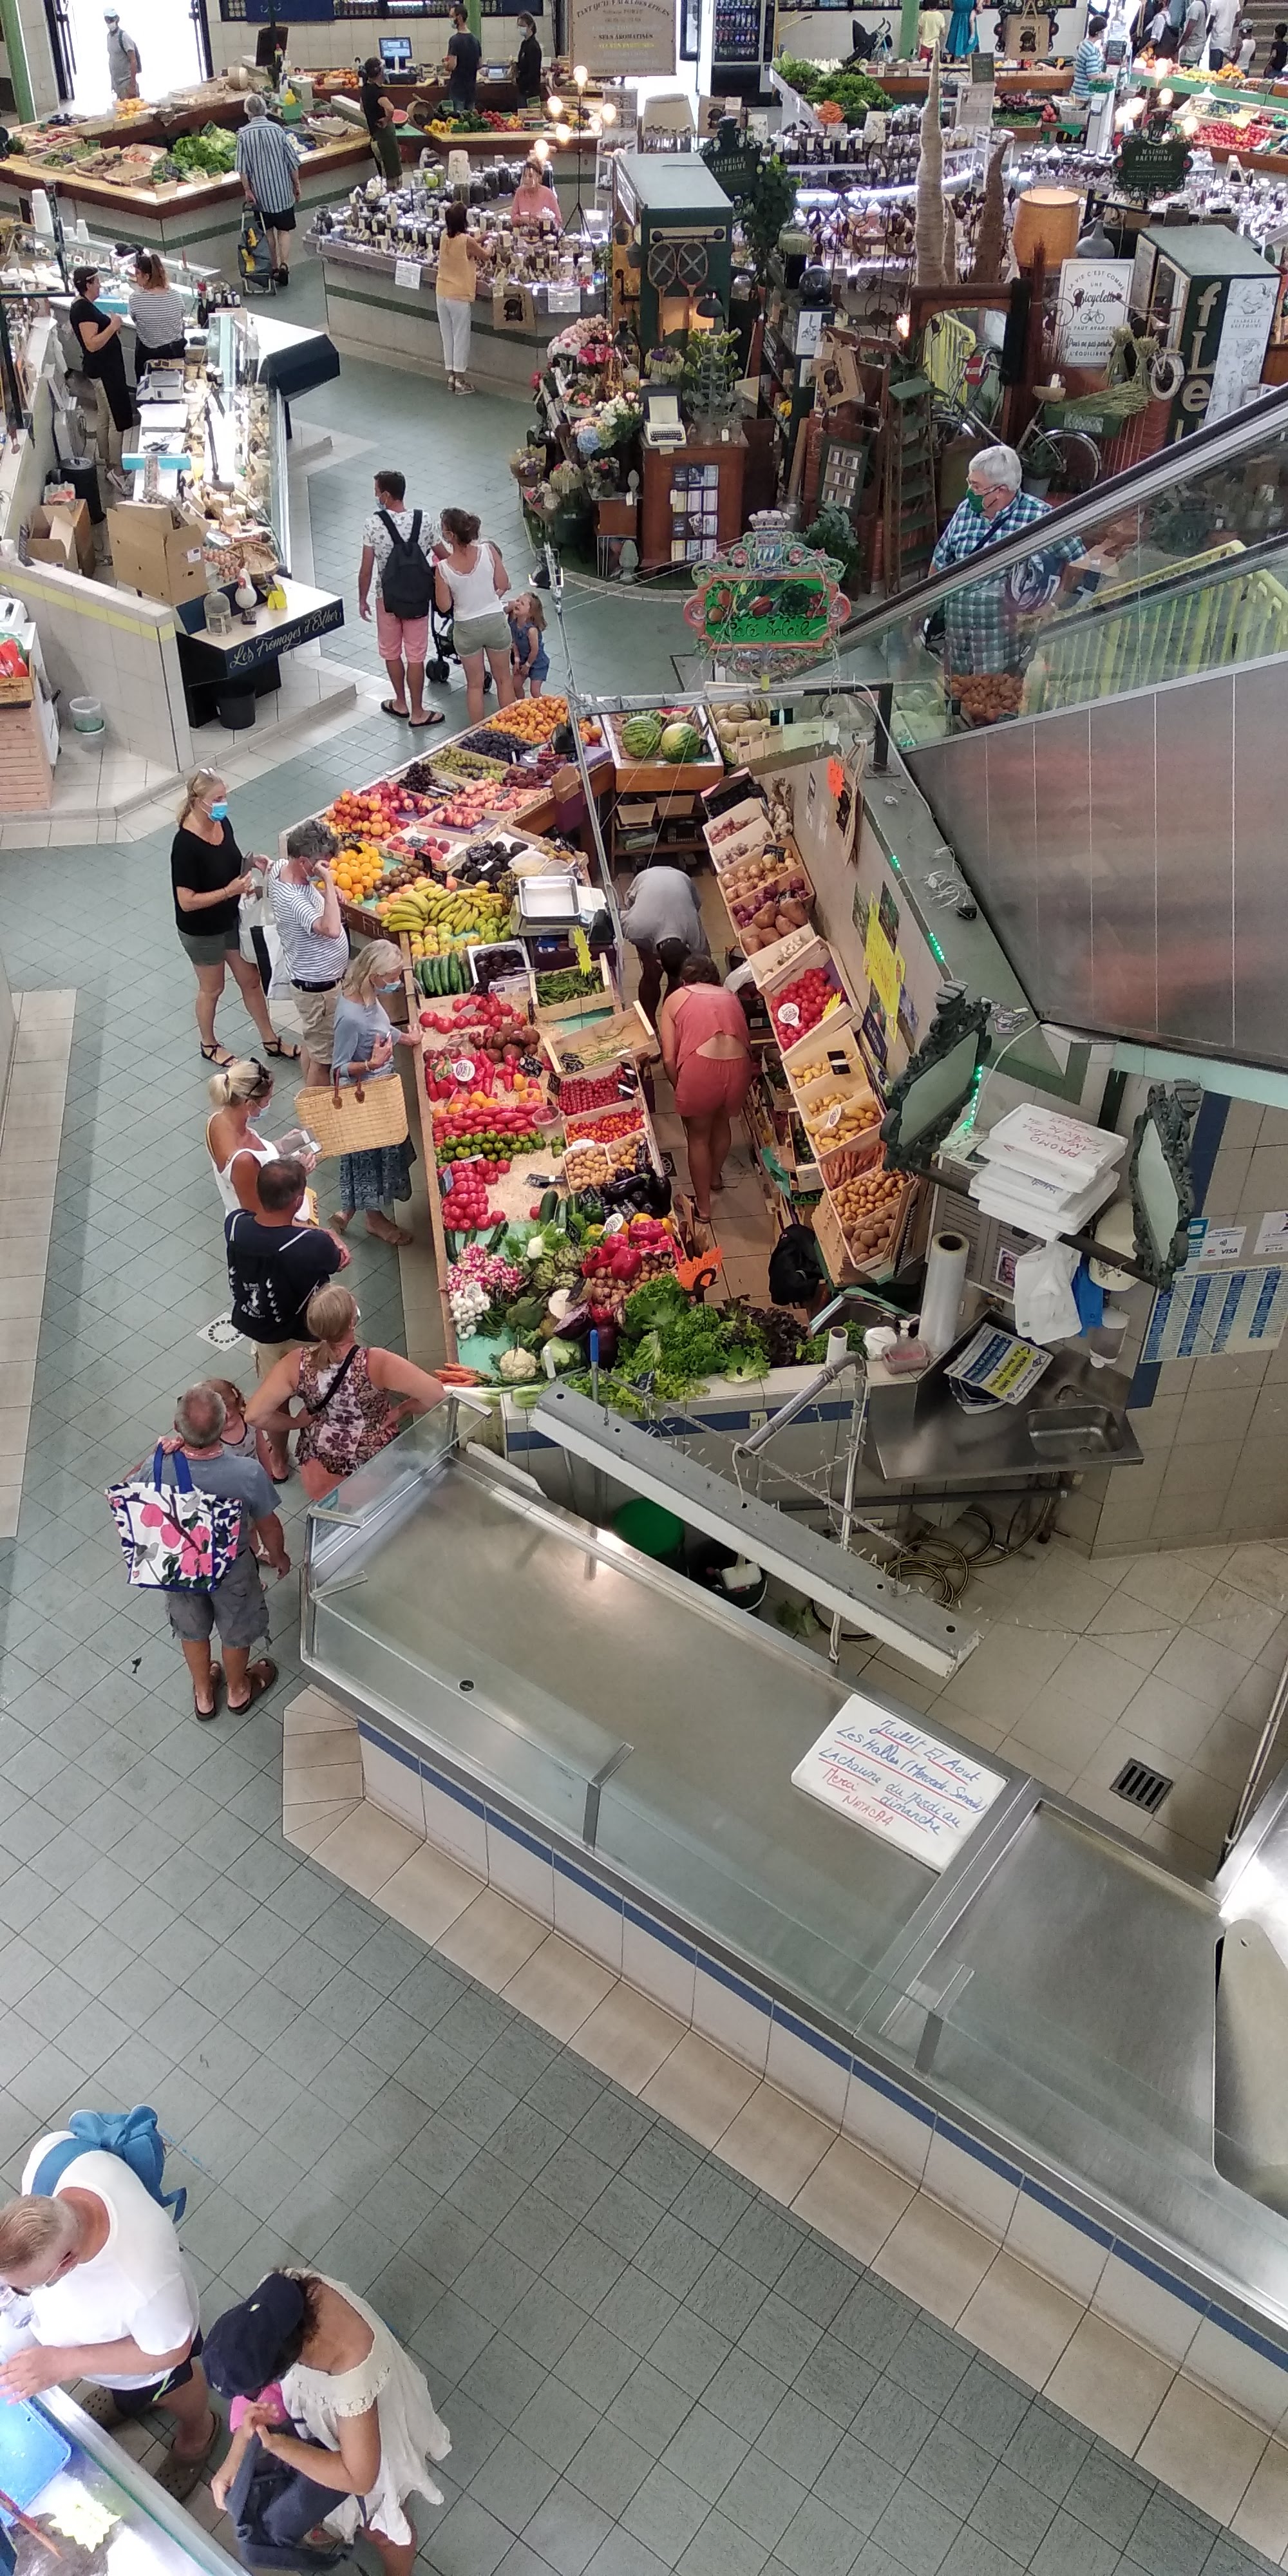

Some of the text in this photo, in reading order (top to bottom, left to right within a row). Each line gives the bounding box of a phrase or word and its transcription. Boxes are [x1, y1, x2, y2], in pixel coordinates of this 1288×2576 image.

[1075, 274, 1085, 283] VIE
[1106, 272, 1125, 290] COMME
[764, 619, 810, 638] Soleil
[229, 645, 254, 669] Les
[256, 625, 301, 658] Fromages
[1029, 1135, 1080, 1158] PROMO
[836, 1726, 865, 1745] Les
[862, 1736, 900, 1766] Halles
[922, 1747, 948, 1761] ET
[822, 1766, 942, 1837] Merci dimanche
[885, 1781, 904, 1797] du
[942, 1810, 961, 1829] au
